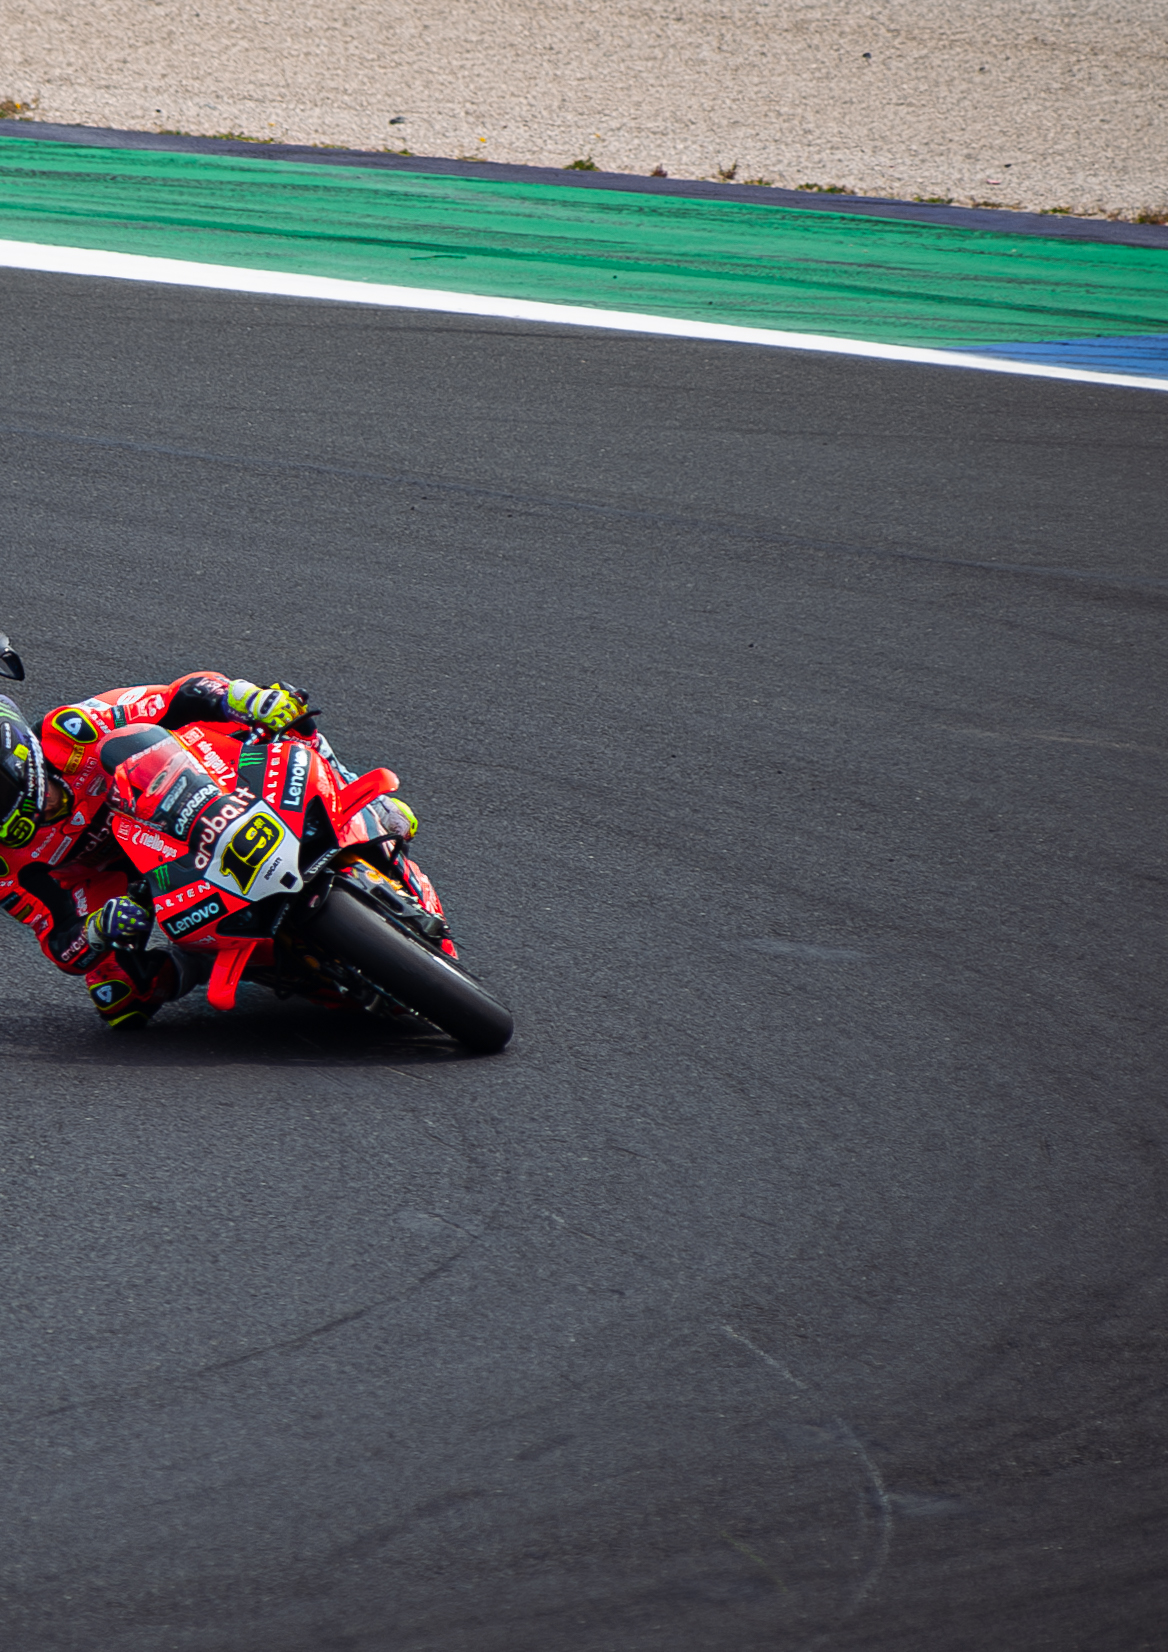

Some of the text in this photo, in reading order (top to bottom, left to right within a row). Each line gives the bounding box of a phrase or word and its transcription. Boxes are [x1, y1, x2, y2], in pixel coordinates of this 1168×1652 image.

[265, 742, 284, 804] ALTEN
[283, 750, 309, 806] Lenovo
[174, 784, 220, 835] CARRERA
[194, 786, 256, 870] aruba.it
[219, 812, 285, 894] 19
[155, 882, 212, 913] ALTEN
[167, 902, 220, 935] Lenovo
